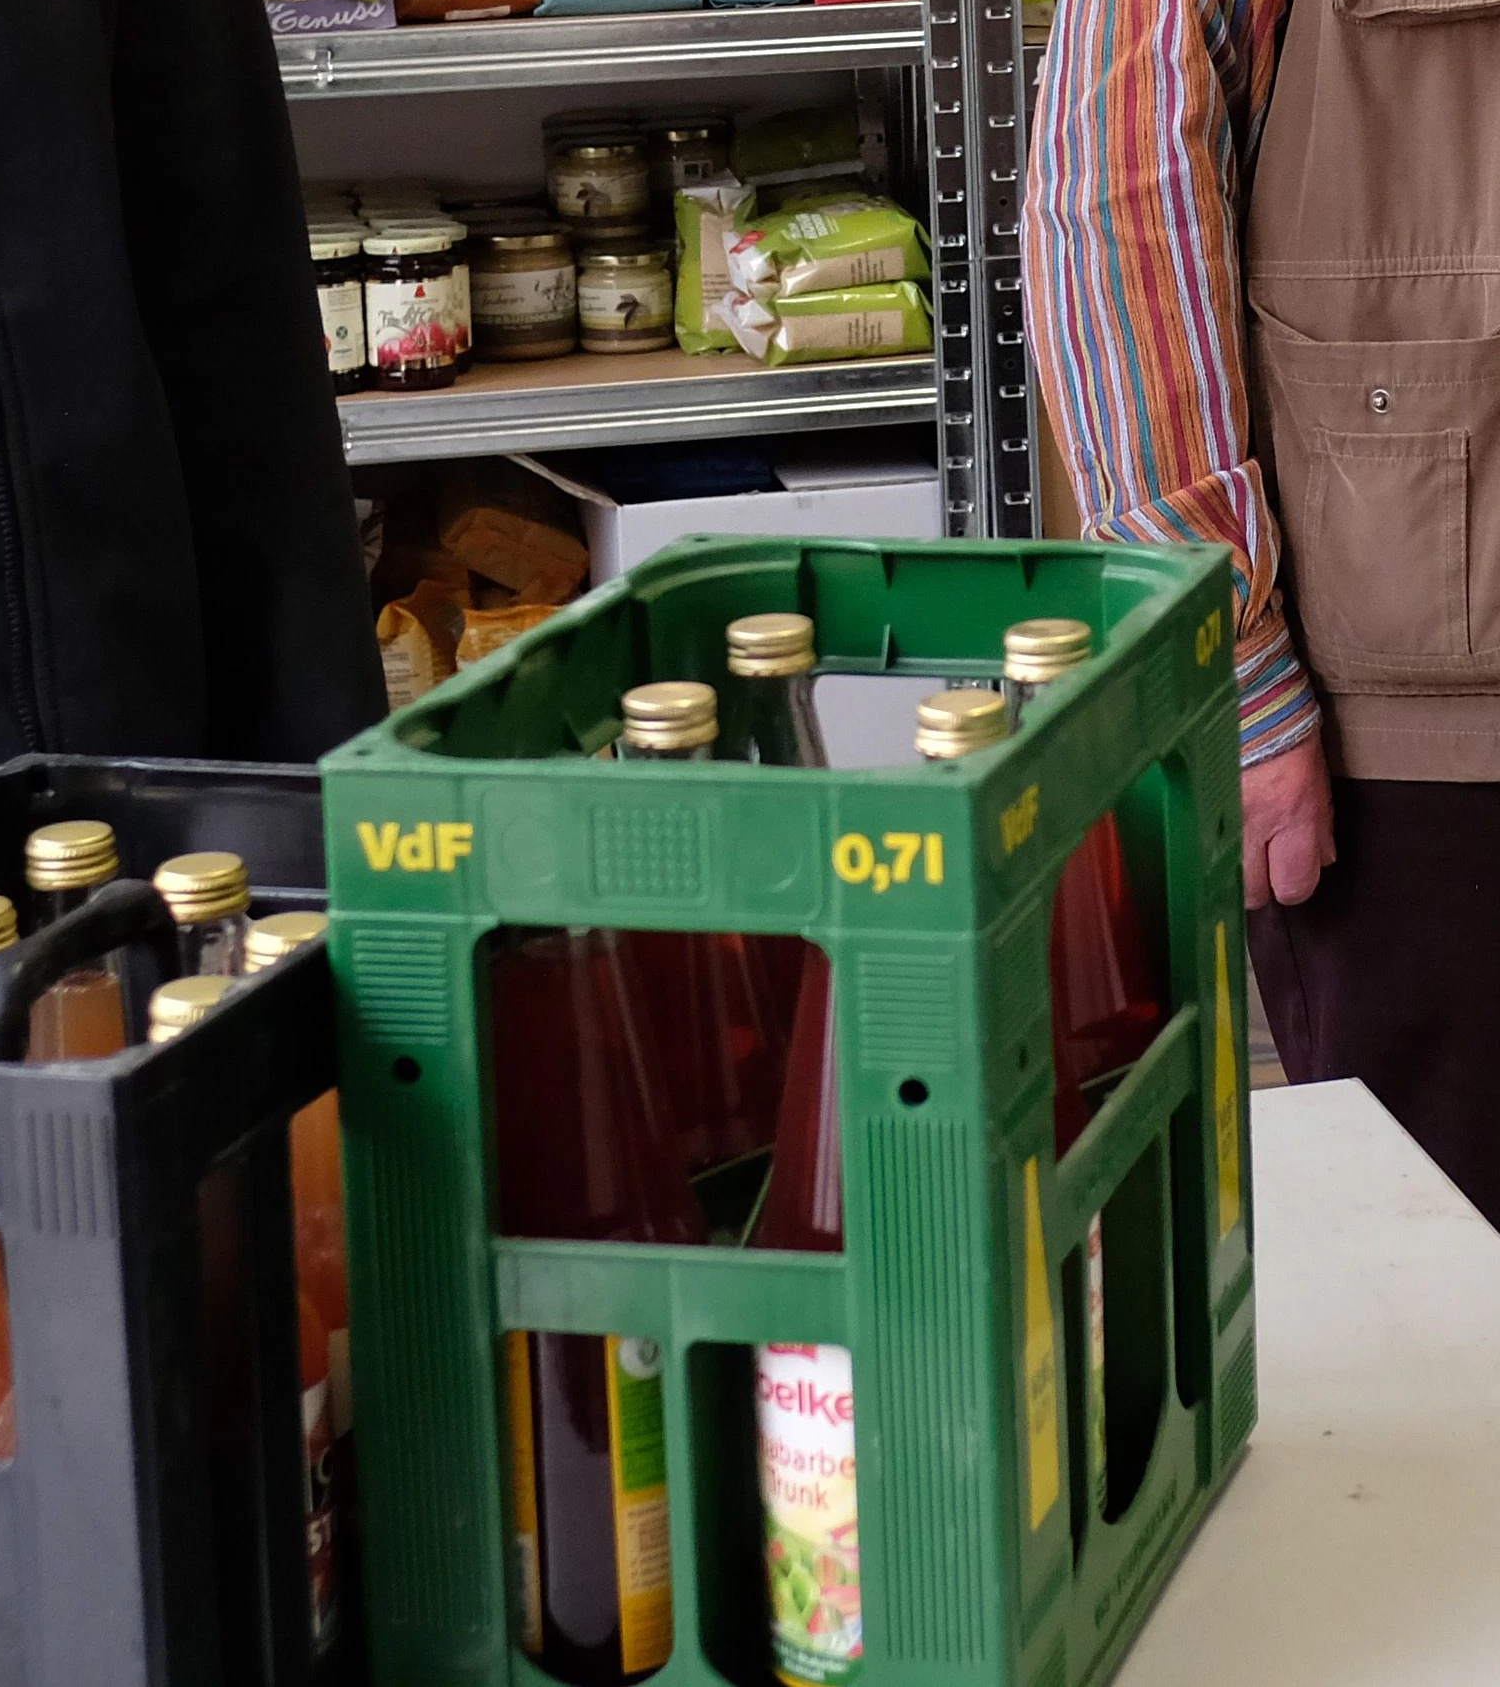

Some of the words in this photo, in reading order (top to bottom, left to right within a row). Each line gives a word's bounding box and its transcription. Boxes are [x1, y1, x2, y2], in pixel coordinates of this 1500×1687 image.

[271, 0, 386, 33] Genuss
[356, 822, 474, 872] VdF
[755, 1369, 854, 1427] oelke
[768, 1465, 830, 1511] Trunk
